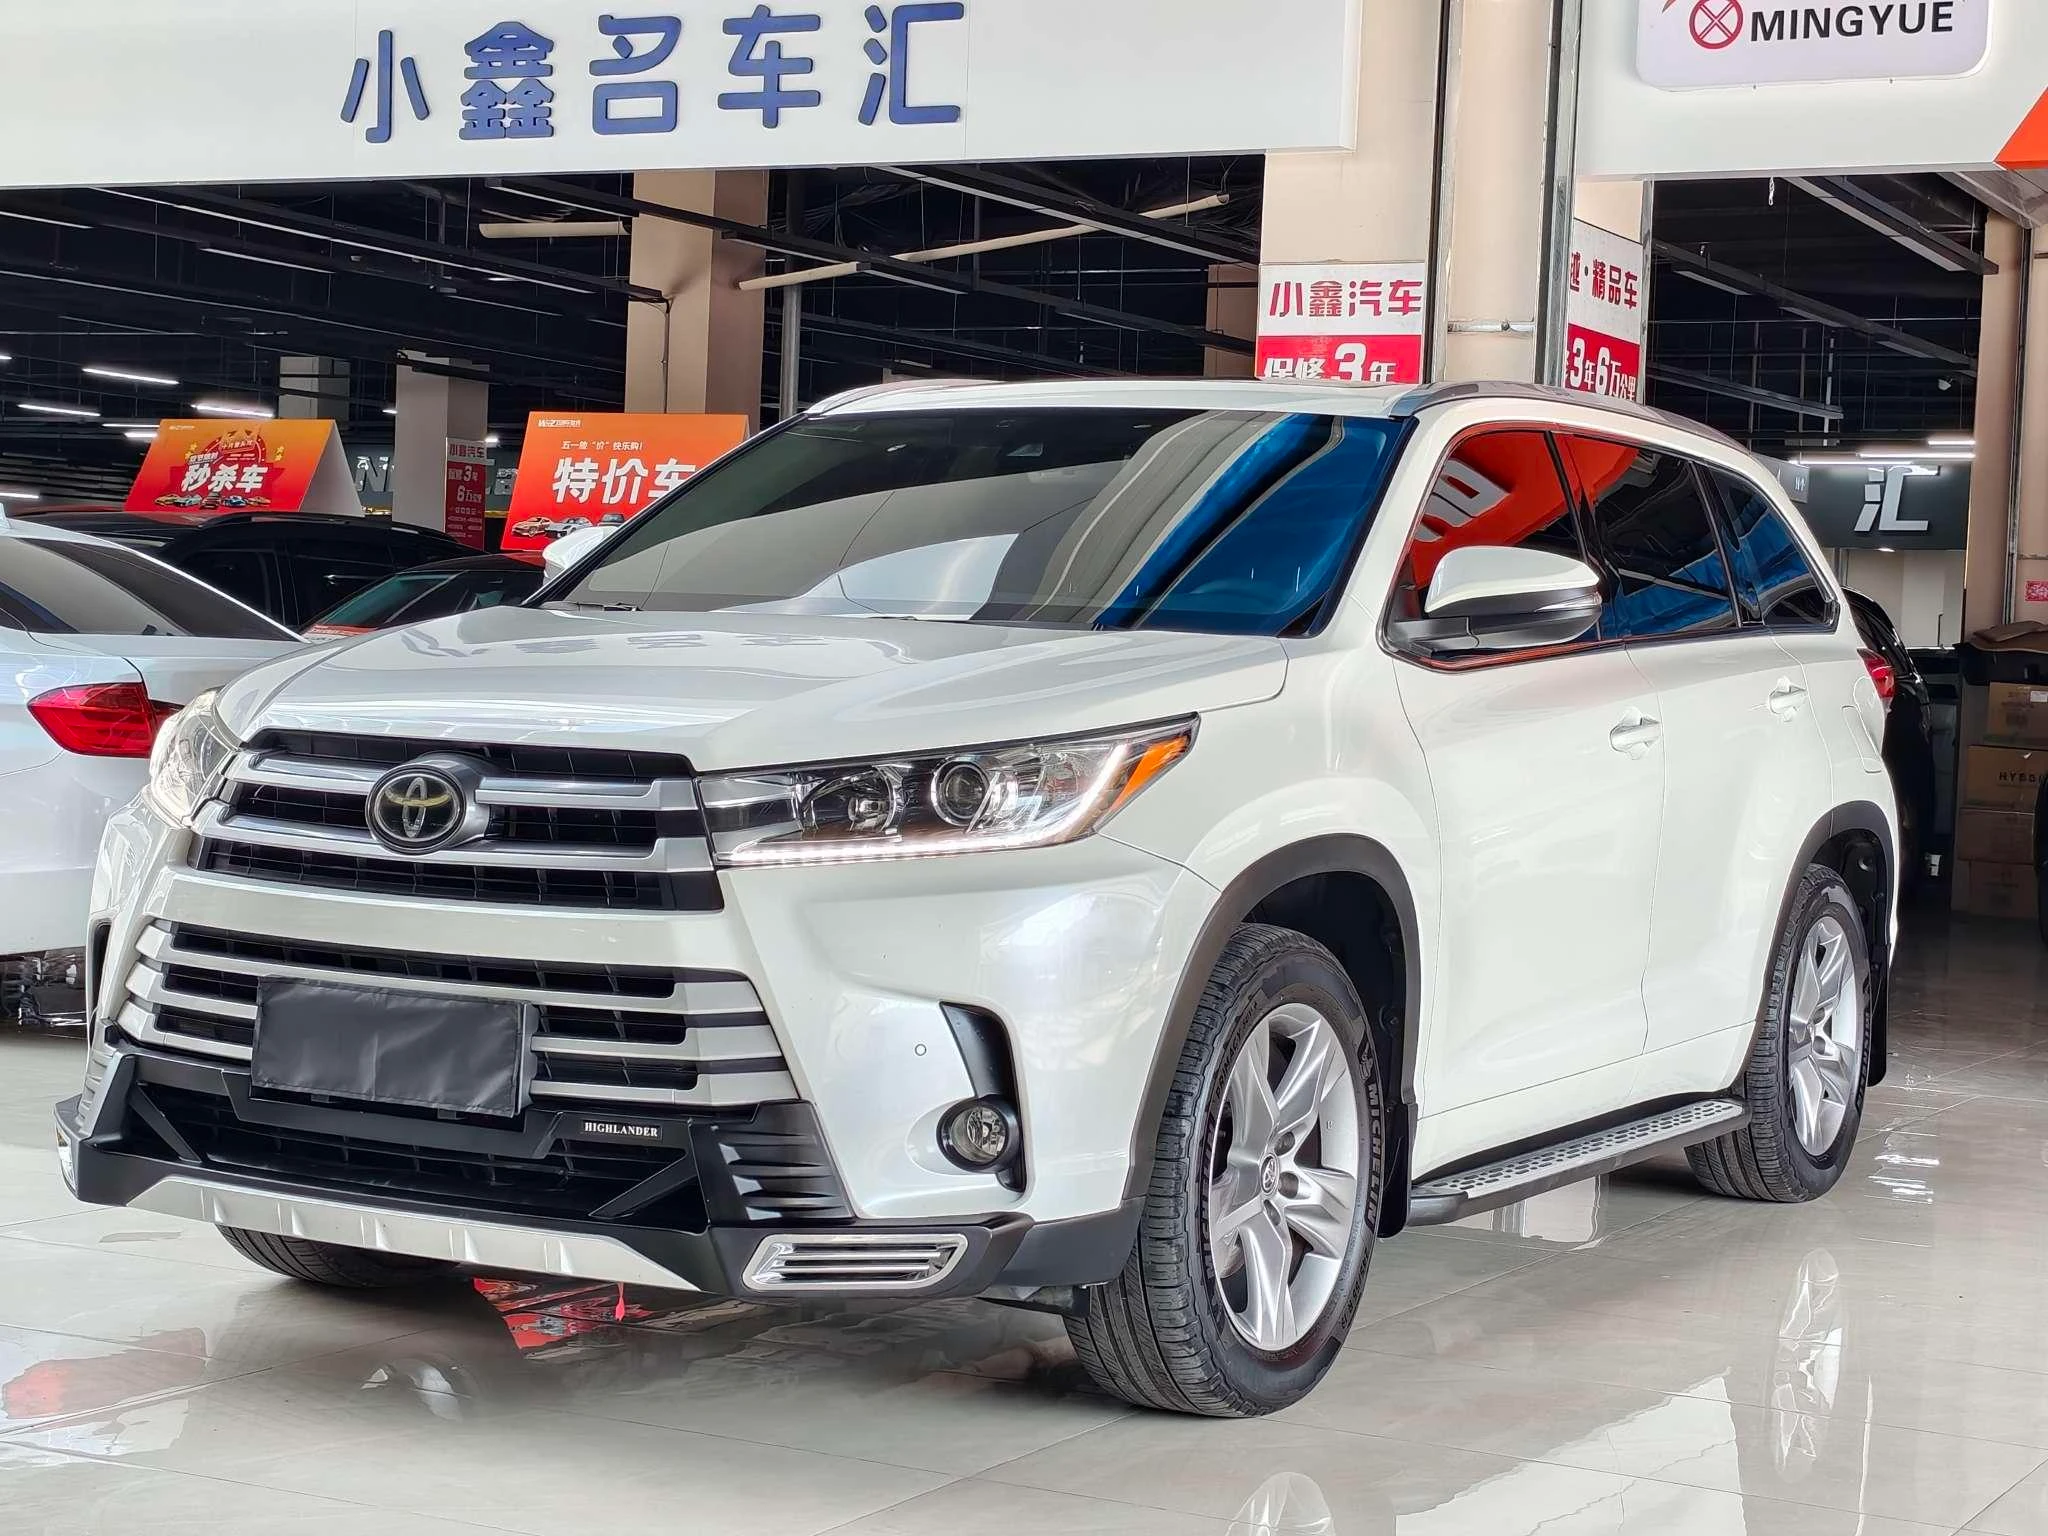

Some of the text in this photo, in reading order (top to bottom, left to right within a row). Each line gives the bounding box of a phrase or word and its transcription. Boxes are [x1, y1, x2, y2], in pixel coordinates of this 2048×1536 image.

[1750, 1, 1954, 42] MINGYUE
[339, 2, 965, 144] 小鑫名车汇
[1269, 279, 1423, 318] 小鑫汽车
[181, 463, 268, 493] 秒杀车
[552, 456, 697, 505] 特价车
[1853, 464, 1941, 532] 汇
[584, 1122, 658, 1137] HIGHLANDER
[1366, 1082, 1382, 1229] MICHELIN
